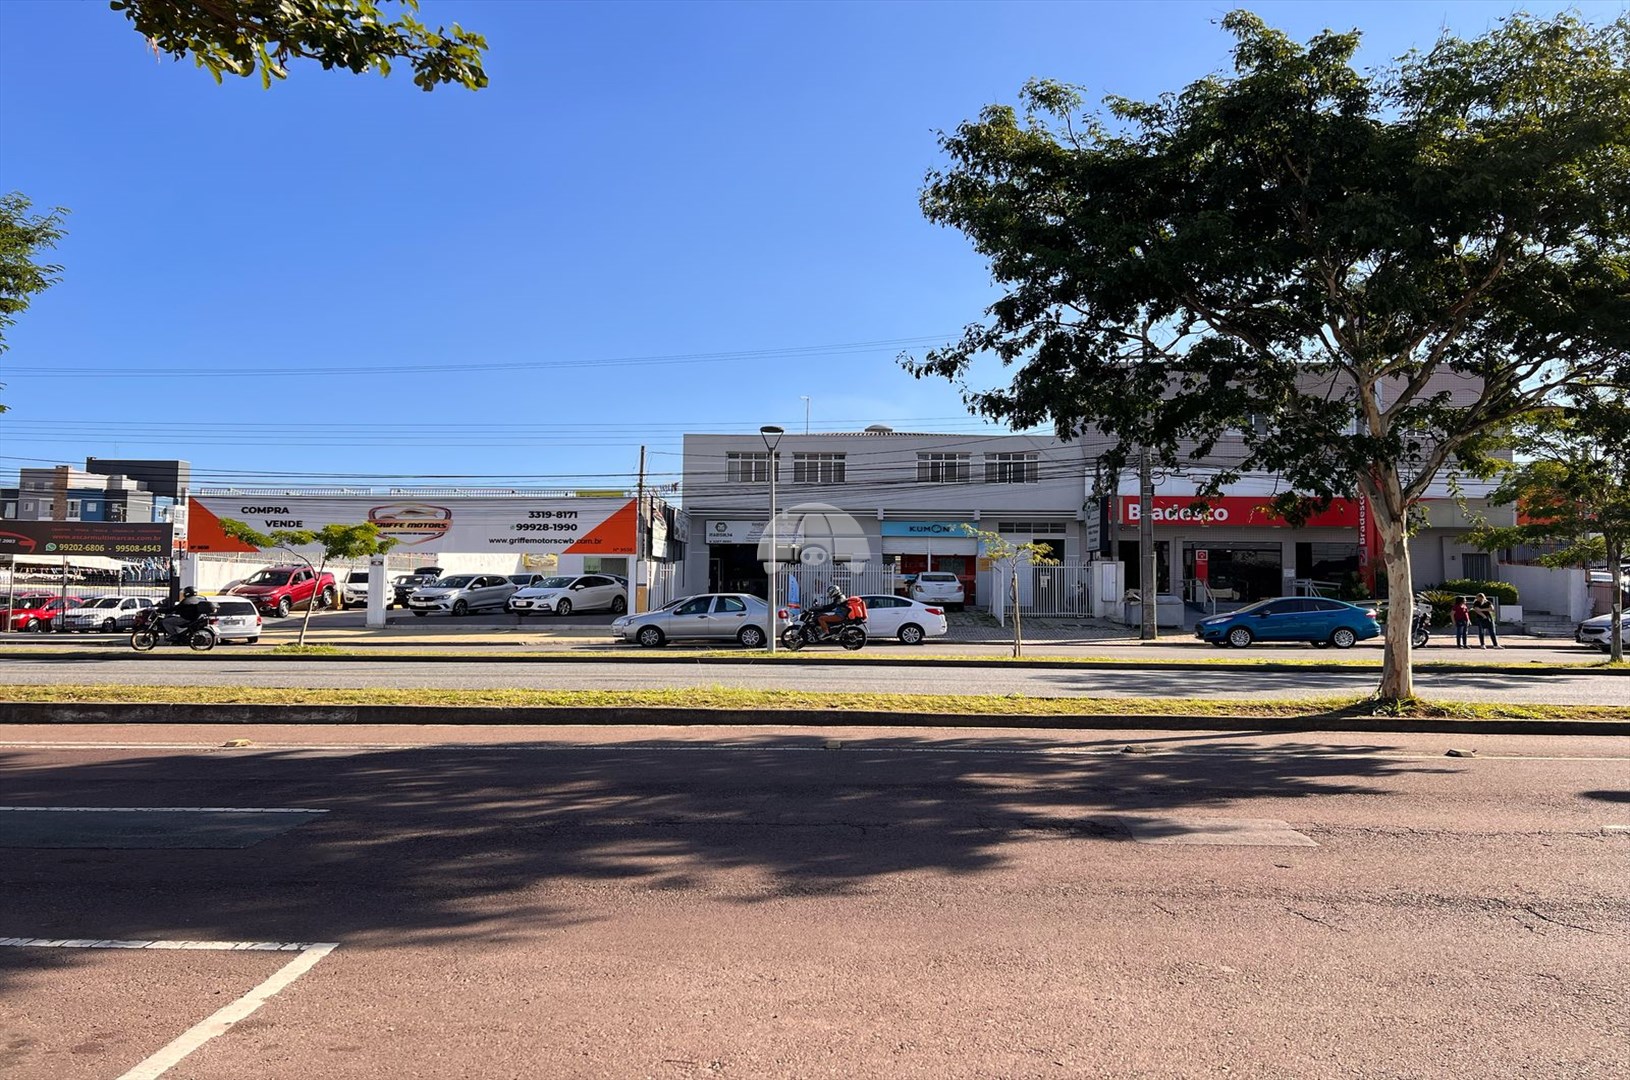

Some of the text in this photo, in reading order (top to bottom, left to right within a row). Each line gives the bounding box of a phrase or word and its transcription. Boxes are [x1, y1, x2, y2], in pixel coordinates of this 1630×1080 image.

[241, 506, 290, 514] COMPRA
[528, 510, 578, 518] 3319-8171
[1128, 503, 1229, 520] Badesco
[516, 523, 578, 531] 99928-1990
[909, 524, 951, 533] KUMON
[489, 537, 602, 545] www.griffemotorscwbcom.br
[59, 543, 105, 551] 99202-6806
[115, 544, 162, 552] 99508-4543
